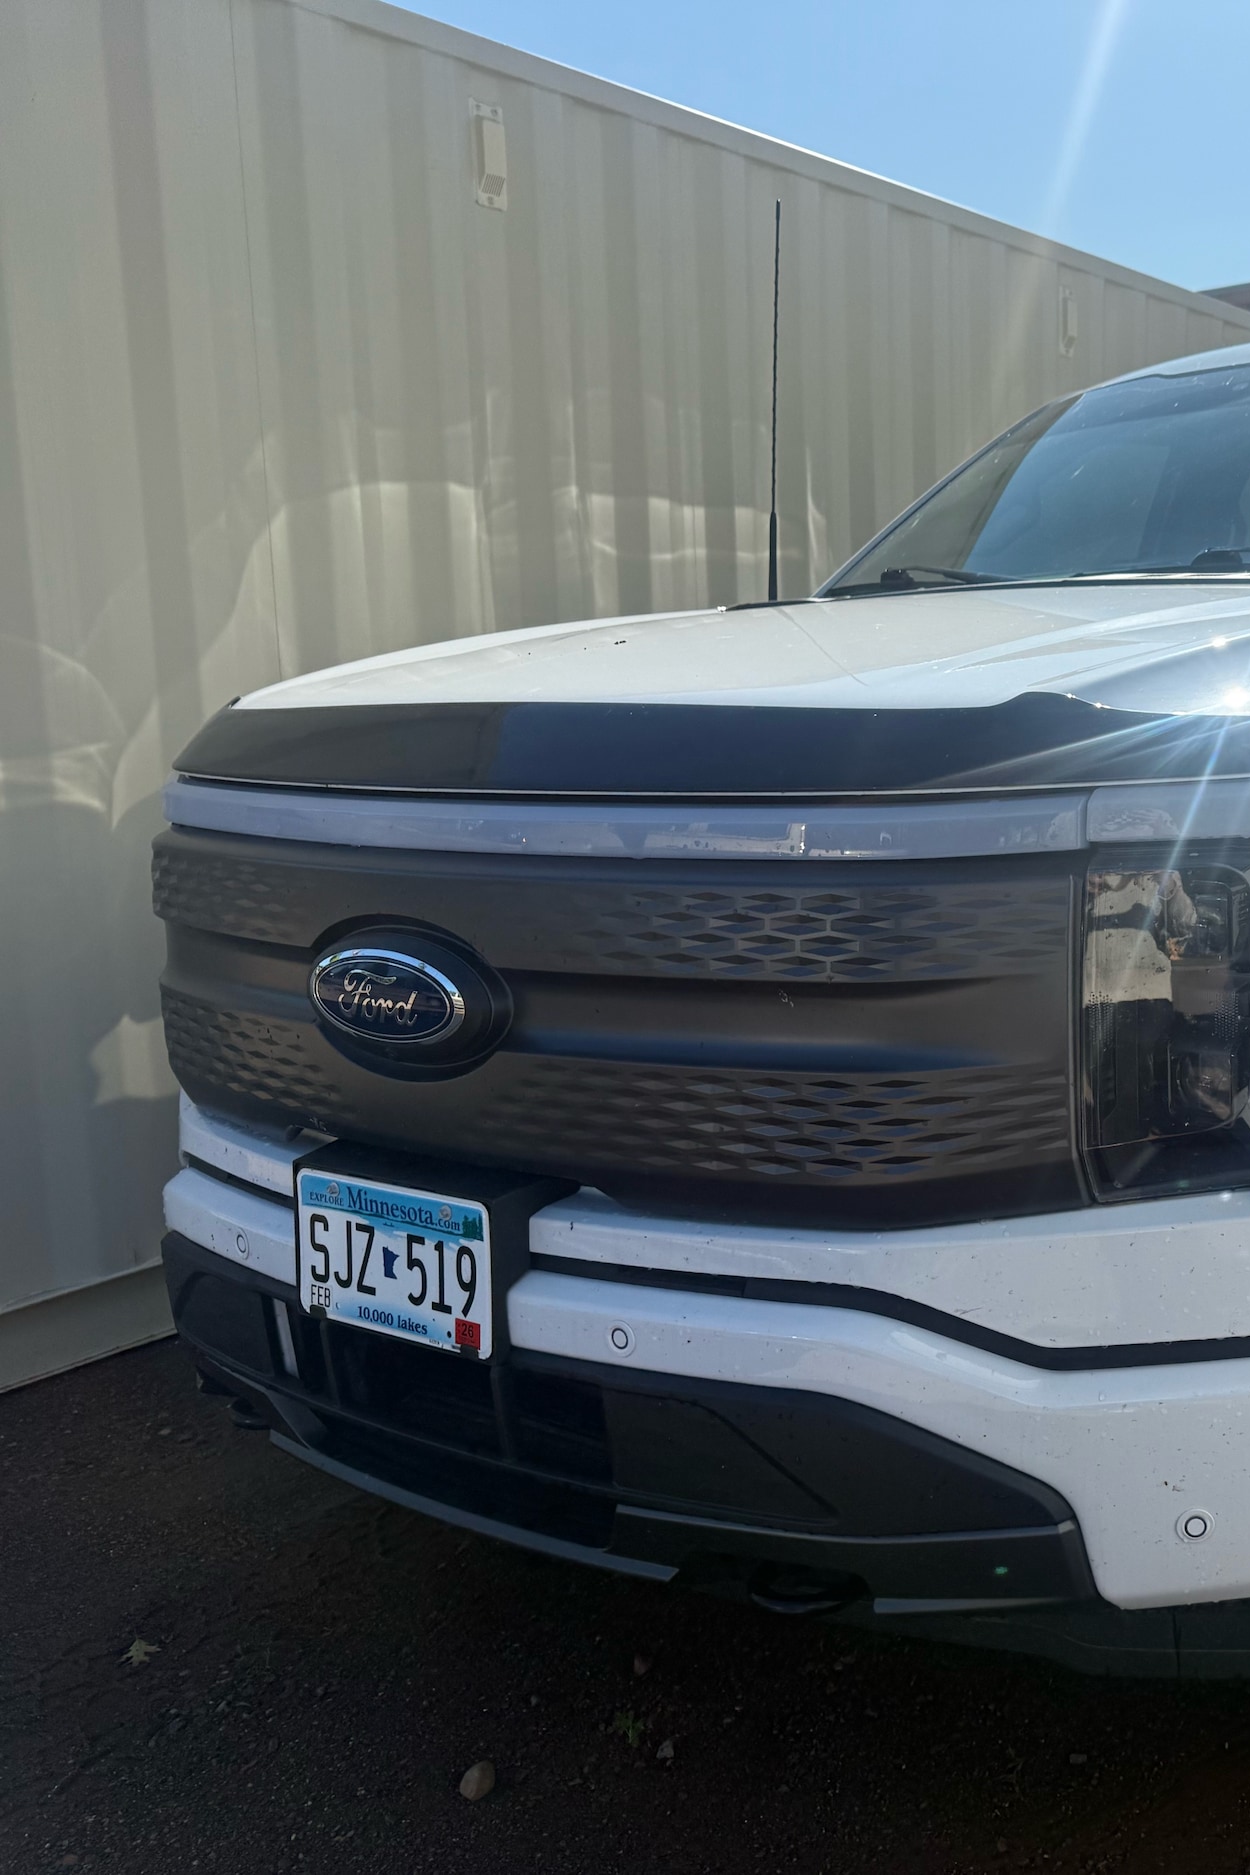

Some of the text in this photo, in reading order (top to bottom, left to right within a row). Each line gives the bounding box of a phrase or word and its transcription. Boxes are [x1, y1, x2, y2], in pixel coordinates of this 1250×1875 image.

[338, 969, 418, 1027] Ford
[309, 1191, 344, 1207] EXPLORE
[309, 1213, 477, 1318] SJZ 519
[310, 1284, 331, 1308] FEB
[357, 1305, 428, 1335] 10,000 lakes
[461, 1323, 474, 1339] 26
